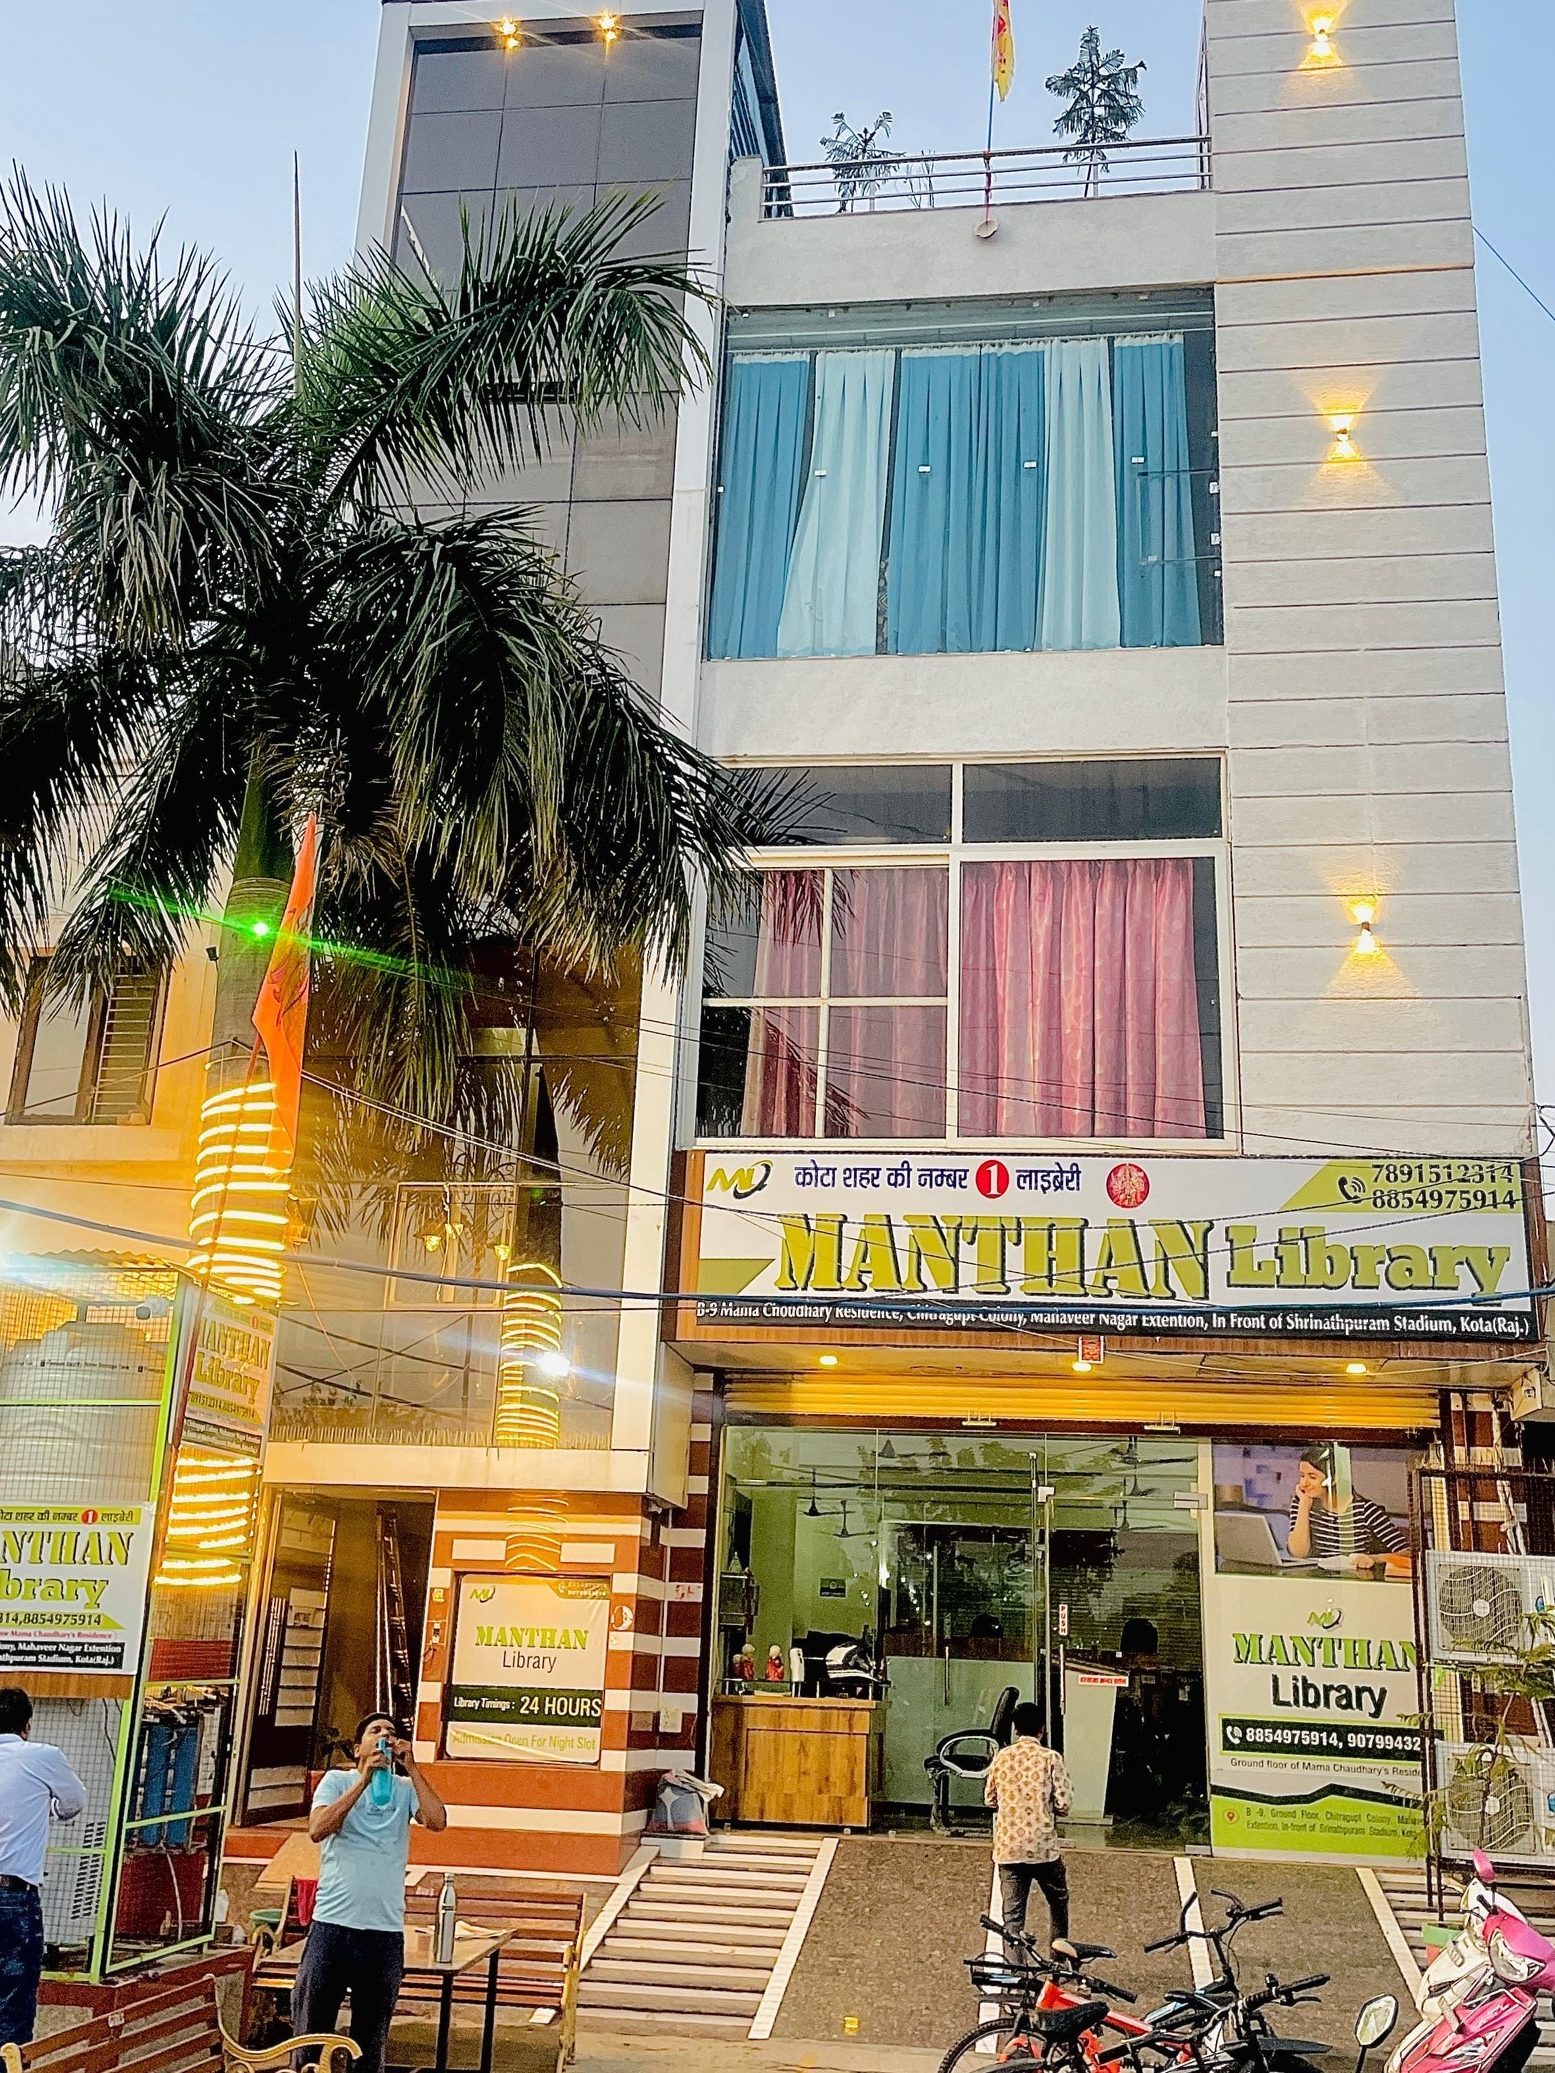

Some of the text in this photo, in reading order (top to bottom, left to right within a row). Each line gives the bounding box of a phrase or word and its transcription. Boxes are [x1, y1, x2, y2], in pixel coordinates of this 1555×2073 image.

[794, 1159, 1082, 1195] कोटा शहर की नम्बर 1 लाइब्रेरी
[1371, 1163, 1514, 1184] 7891512314
[1372, 1189, 1516, 1209] 8854975914
[774, 1212, 1511, 1307] MANTHAN Library
[696, 1301, 718, 1317] B-9
[763, 1302, 832, 1323] Choudhary
[1099, 1313, 1138, 1330] Nagar
[1142, 1313, 1208, 1331] Extention,
[1212, 1313, 1226, 1328] In
[1230, 1314, 1265, 1329] Front
[1269, 1313, 1283, 1329] of
[1286, 1313, 1390, 1335] Shrinathpuram
[1394, 1315, 1457, 1334] Stadium,
[1459, 1316, 1530, 1338] Kota(Raj.)
[194, 1351, 260, 1405] Library
[59, 1643, 82, 1653] Nagar
[475, 1626, 589, 1649] MANTHAN
[502, 1650, 557, 1674] Library
[454, 1696, 481, 1711] Library
[520, 1696, 539, 1714] 24
[544, 1696, 601, 1717] HOURS
[1271, 1673, 1388, 1719] Library
[531, 1734, 547, 1747] For
[550, 1735, 575, 1751] Night
[577, 1736, 596, 1750] Slot
[1245, 1727, 1344, 1749] 8854975914,
[1230, 1757, 1264, 1768] Ground
[1266, 1759, 1288, 1769] floor
[1290, 1761, 1299, 1770] of
[1302, 1762, 1331, 1772] Mama
[1333, 1763, 1390, 1776] Chaudhary's
[1270, 1808, 1296, 1818] Ground
[1309, 1822, 1316, 1832] of
